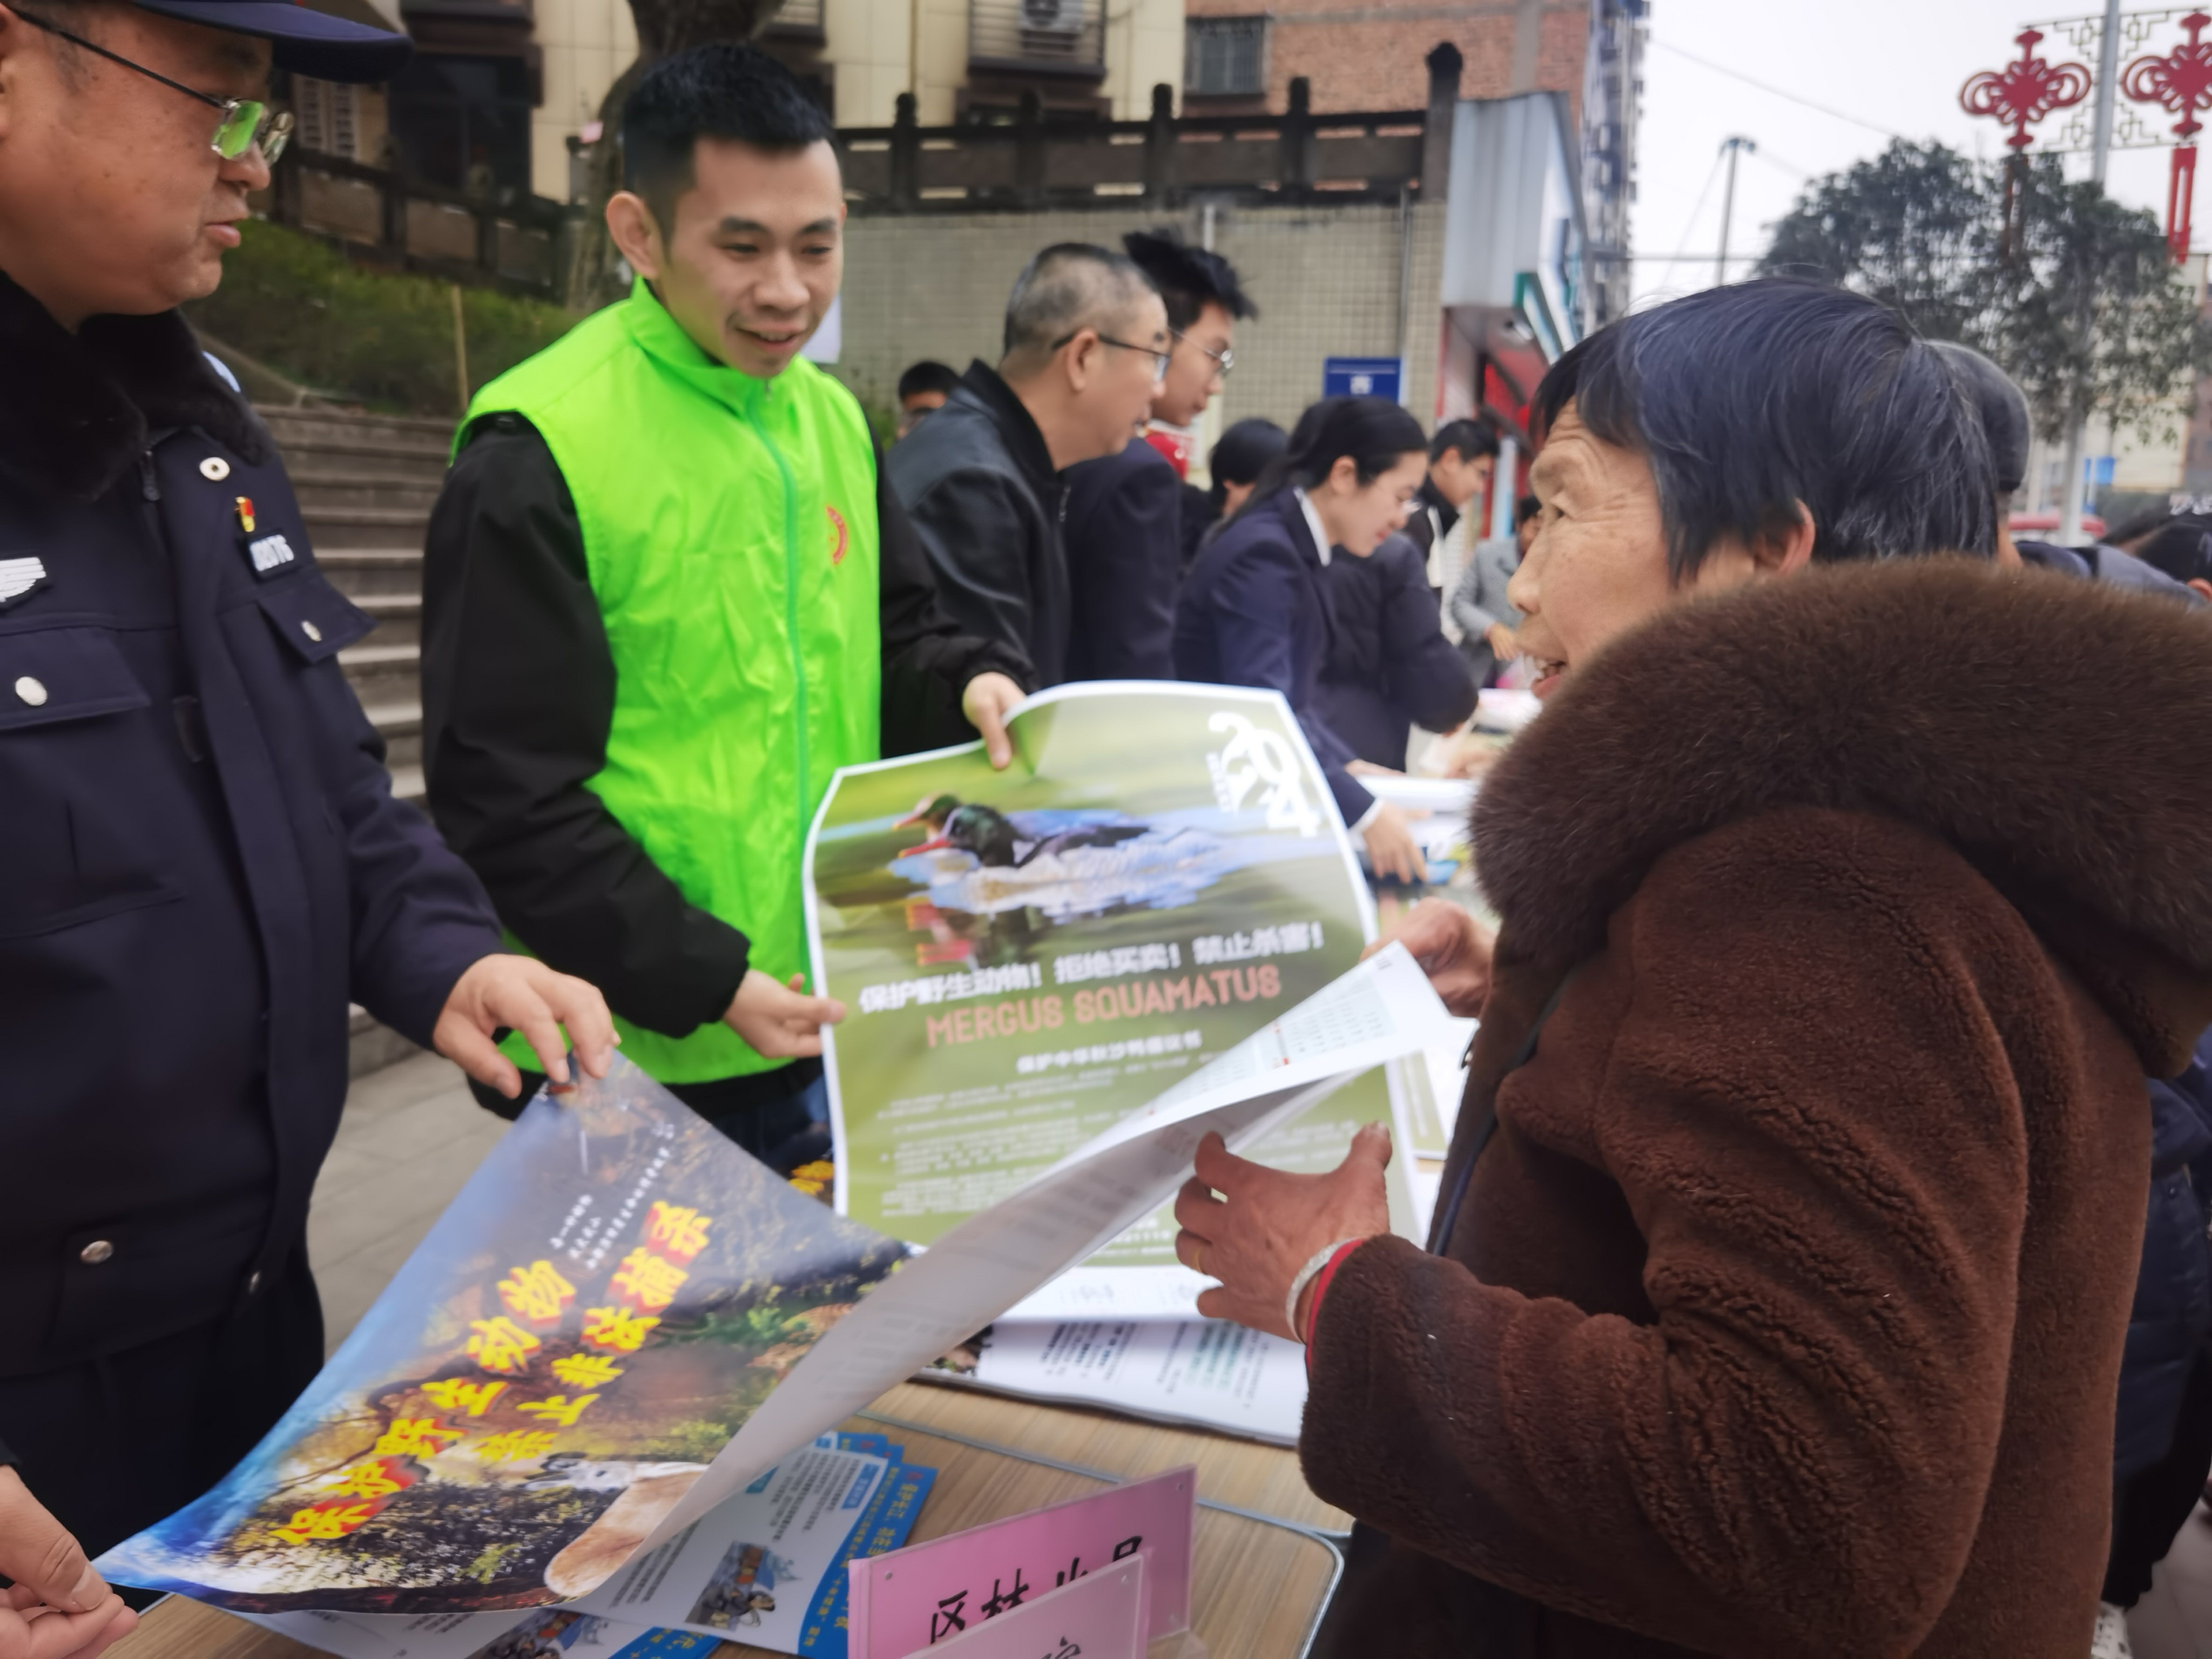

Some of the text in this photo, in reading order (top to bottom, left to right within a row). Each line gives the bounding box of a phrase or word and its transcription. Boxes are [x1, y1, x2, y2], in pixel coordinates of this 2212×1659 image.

[925, 995, 1064, 1048] MERGUS
[1073, 963, 1282, 1024] SQUAMATUS
[268, 1259, 577, 1546] 保护野生动物
[930, 1535, 1143, 1644] 区林
